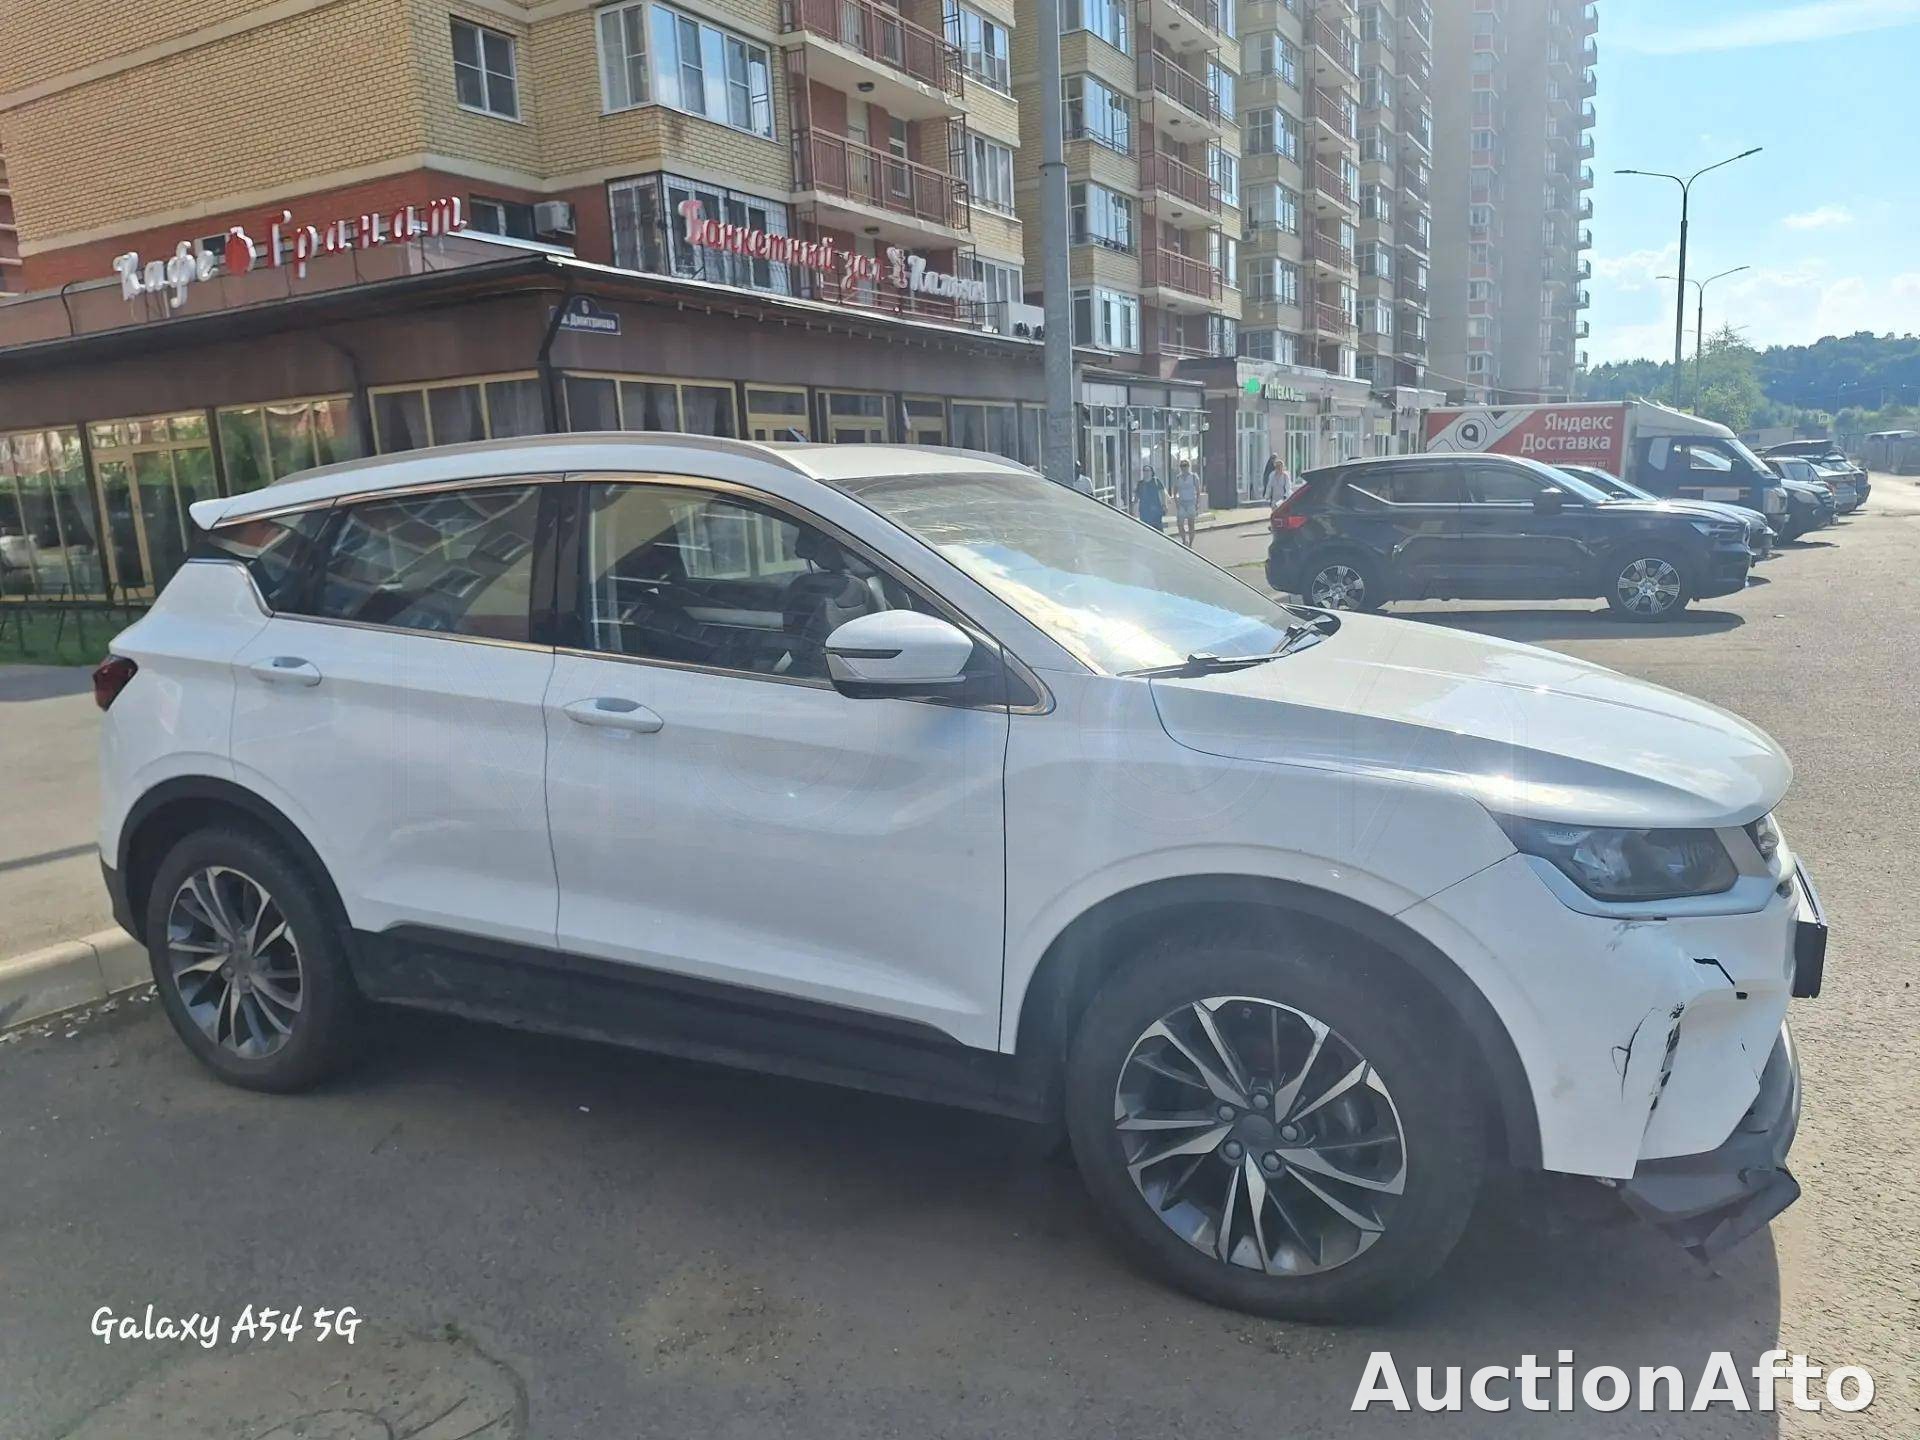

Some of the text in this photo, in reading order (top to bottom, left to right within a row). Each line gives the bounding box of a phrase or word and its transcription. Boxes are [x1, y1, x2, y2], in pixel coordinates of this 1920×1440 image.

[113, 196, 468, 308] Кафе Гранат
[678, 200, 836, 273] Банкетный
[1520, 433, 1612, 454] Доставка
[1544, 412, 1614, 433] Яндекс
